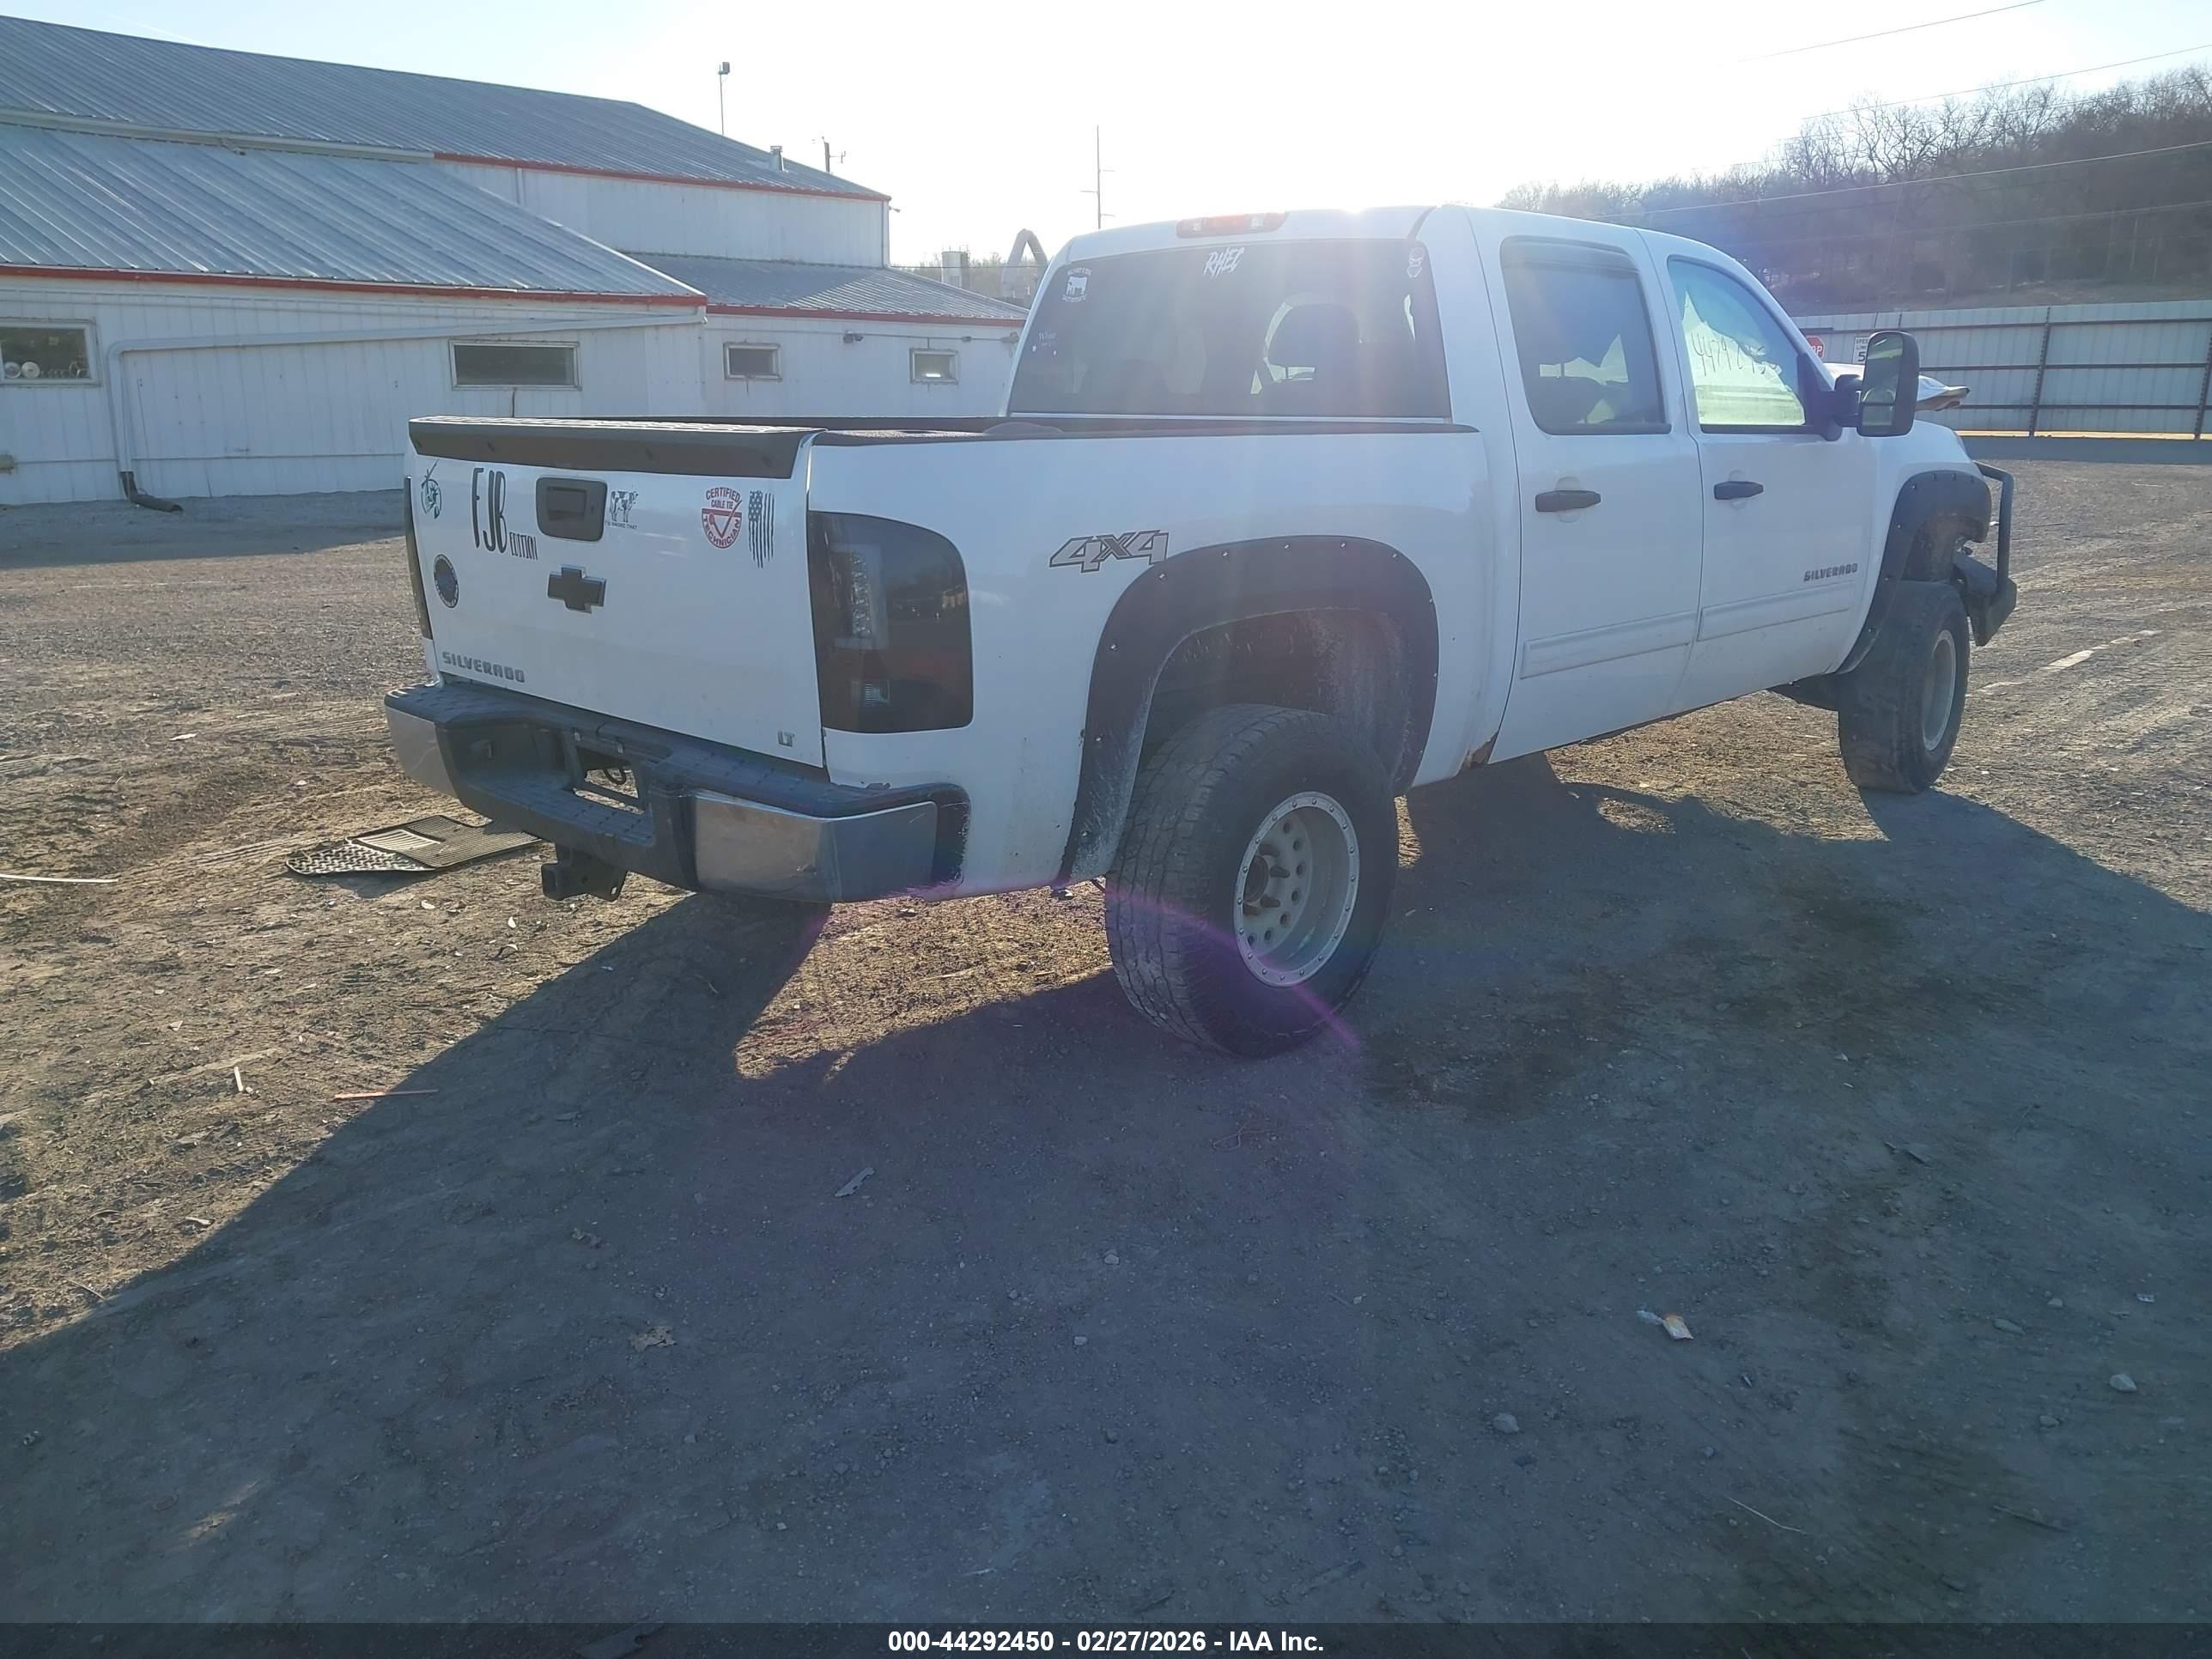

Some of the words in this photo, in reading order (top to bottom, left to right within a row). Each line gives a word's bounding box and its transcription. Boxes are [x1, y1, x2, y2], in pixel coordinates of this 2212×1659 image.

[1810, 345, 1823, 358] OP
[706, 487, 741, 503] CERTIFIED
[472, 467, 507, 554] FJB
[703, 515, 740, 546] TECHNICIAN
[509, 532, 538, 561] EDITION
[1803, 562, 1858, 582] SILVERADO
[442, 651, 526, 684] SILVERADO
[777, 730, 795, 747] LT
